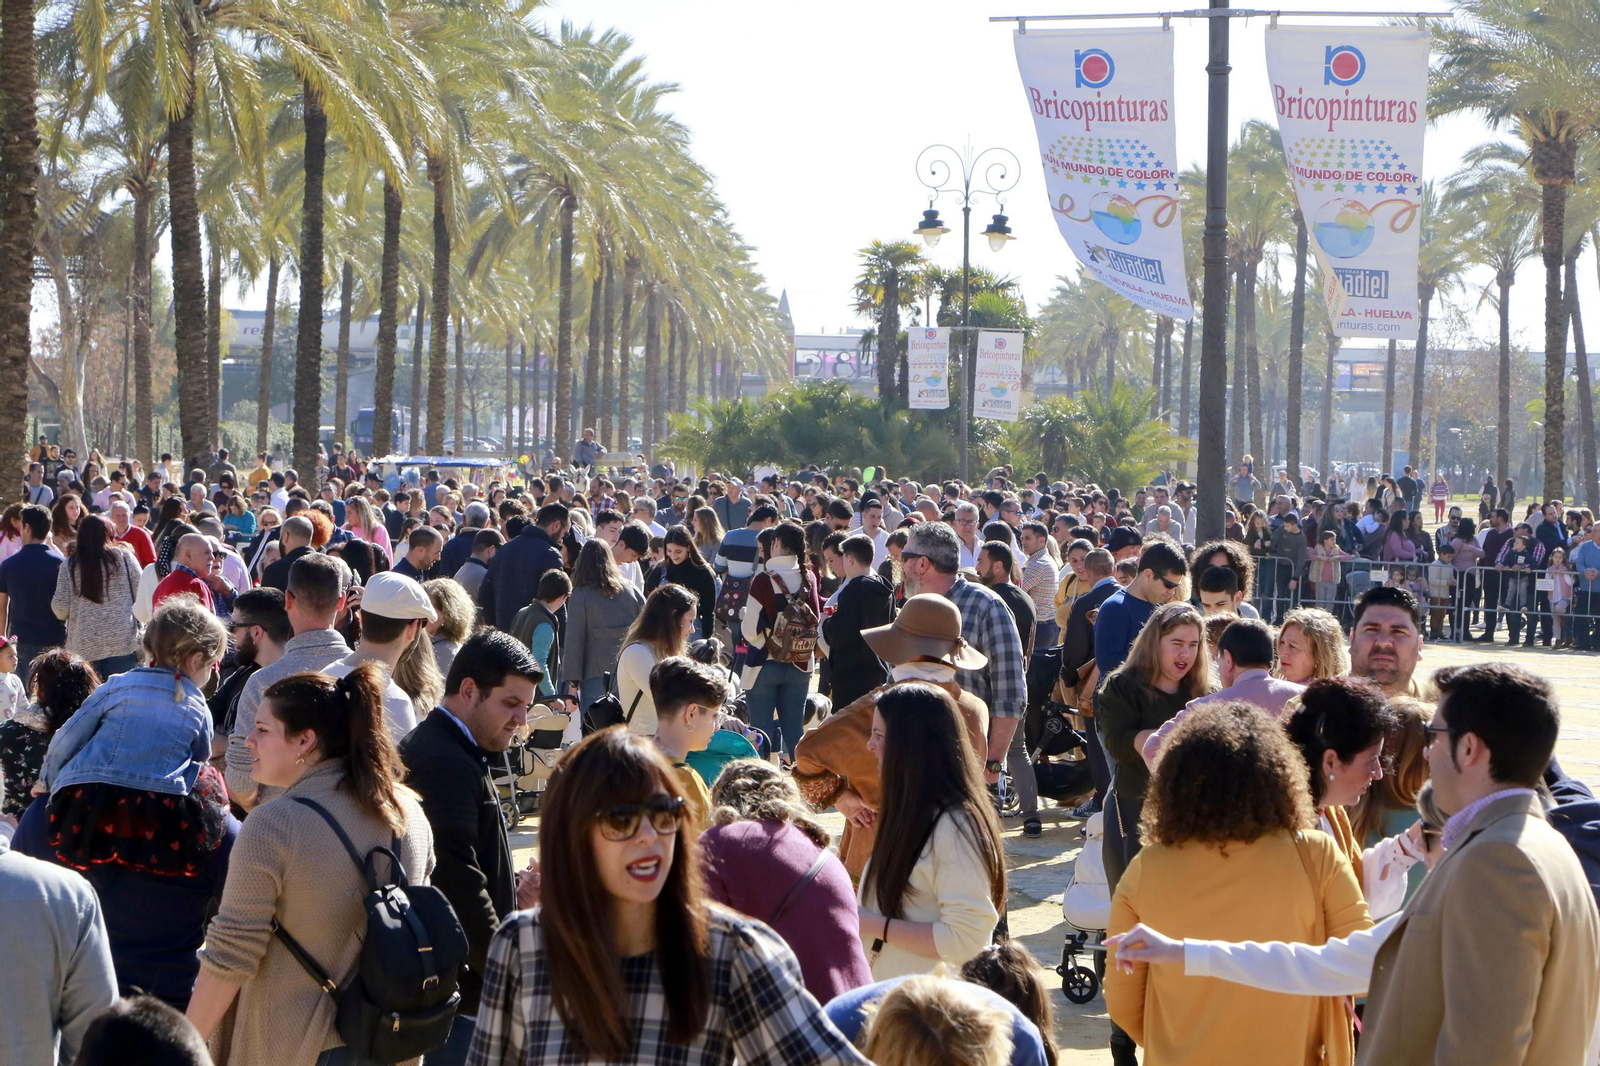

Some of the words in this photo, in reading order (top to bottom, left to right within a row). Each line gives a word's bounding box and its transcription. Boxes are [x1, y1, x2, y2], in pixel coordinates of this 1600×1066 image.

[1028, 86, 1169, 131] Bricopinturas
[1273, 84, 1417, 132] Bricopinturas
[1060, 161, 1105, 175] MUNDO
[1107, 167, 1124, 178] DE
[1126, 168, 1171, 180] COLOR
[1296, 166, 1341, 180] MUNDO
[1345, 170, 1363, 181] DE
[1366, 171, 1413, 183] COLOR
[1108, 250, 1164, 284] Guadiel
[1150, 290, 1189, 307] HUELVA
[1364, 309, 1413, 320] HUELVA
[980, 349, 1021, 362] Bricopinturas
